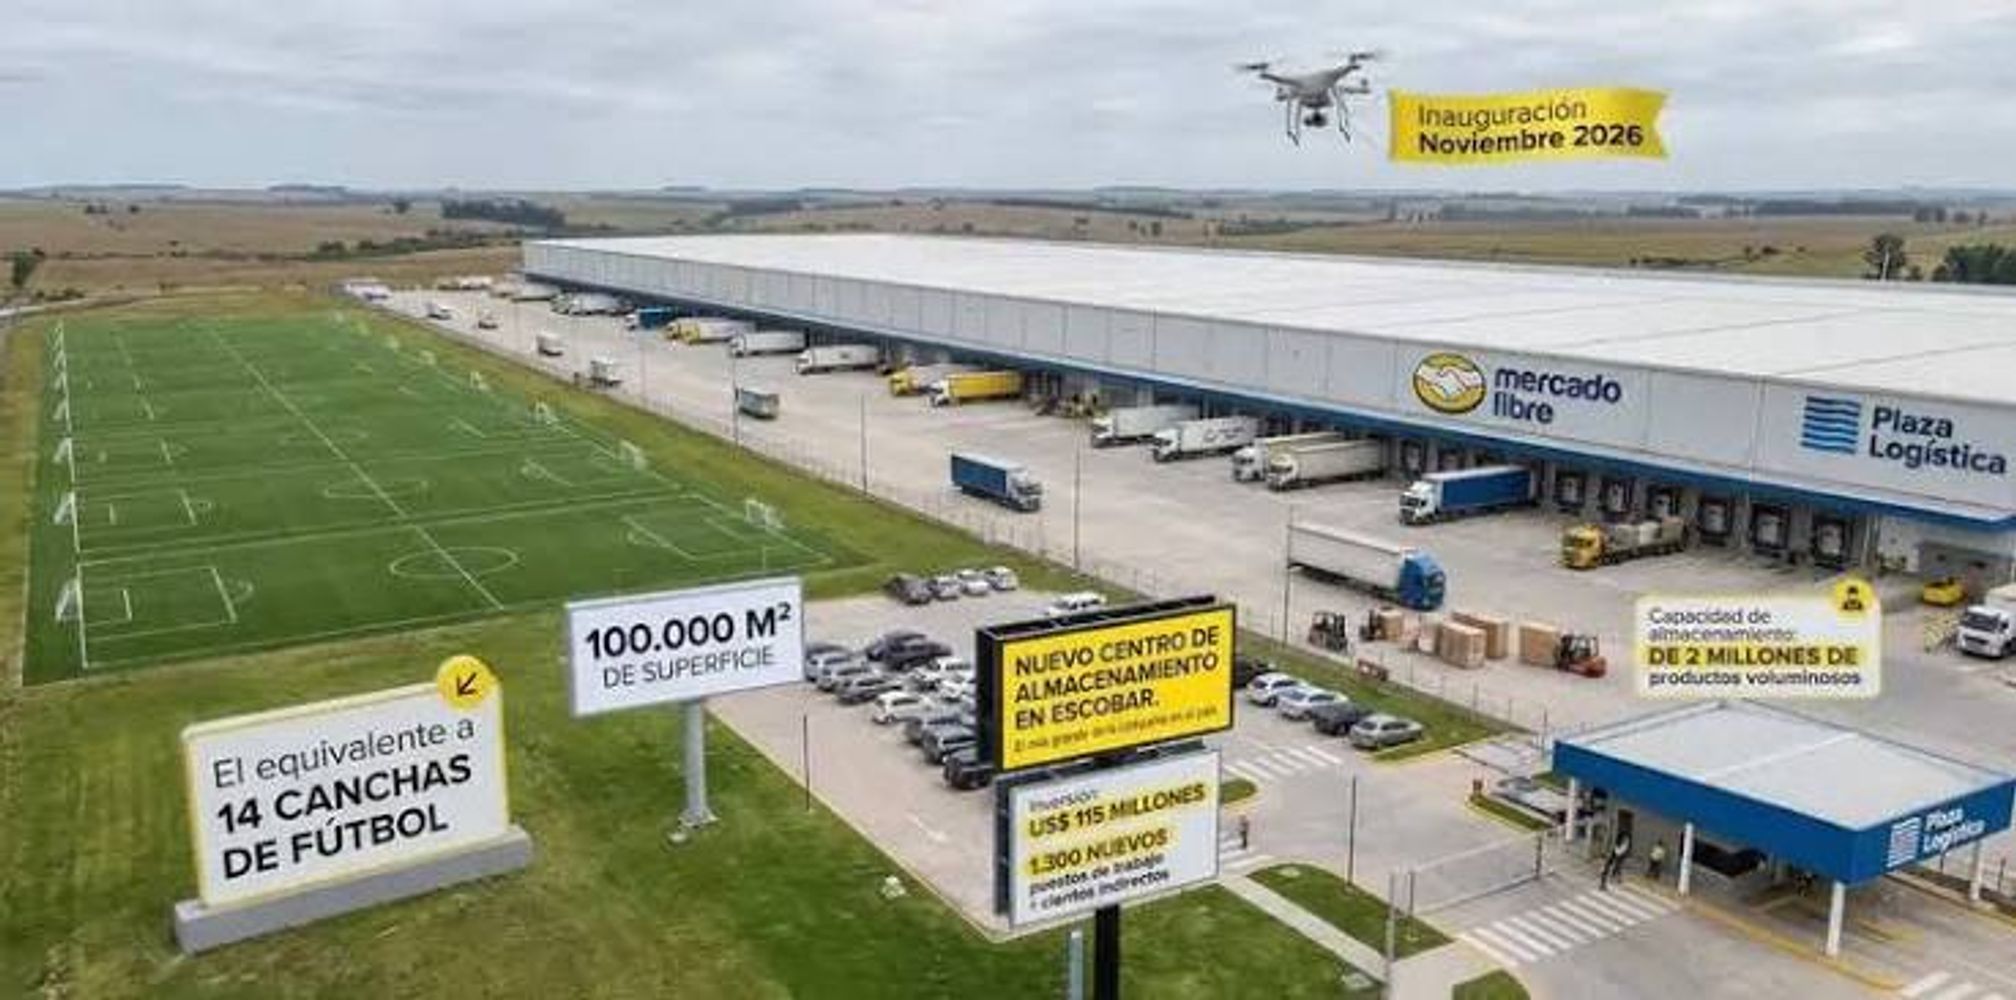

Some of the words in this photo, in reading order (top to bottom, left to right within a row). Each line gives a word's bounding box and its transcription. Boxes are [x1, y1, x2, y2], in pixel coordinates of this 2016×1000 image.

[1494, 366, 1622, 402] mercado
[1494, 393, 1554, 424] libre
[1872, 406, 1954, 438] Plaza
[1870, 438, 2006, 475] Logística
[586, 613, 734, 660] 100.000
[1016, 647, 1094, 676] NUEVO
[1100, 633, 1186, 663] CENTRO
[1191, 626, 1220, 647] DE
[604, 665, 635, 689] DE
[643, 645, 774, 682] SUPERFICIE
[1015, 653, 1219, 703] ALMACENAMIENTO
[1016, 708, 1044, 731] EN
[1052, 688, 1159, 723] ESCOBAR.
[214, 758, 244, 788] El
[256, 722, 446, 781] equivalente
[457, 718, 475, 740] a
[217, 798, 262, 834] 14
[274, 754, 472, 821] CANCHAS
[1029, 813, 1070, 837] US$
[1075, 806, 1105, 826] 115
[1109, 783, 1205, 820] MILLONES
[223, 840, 279, 879] DE
[292, 803, 448, 864] FÚTBOL
[1029, 850, 1081, 876] 1.300
[1086, 828, 1168, 861] NUEVOS
